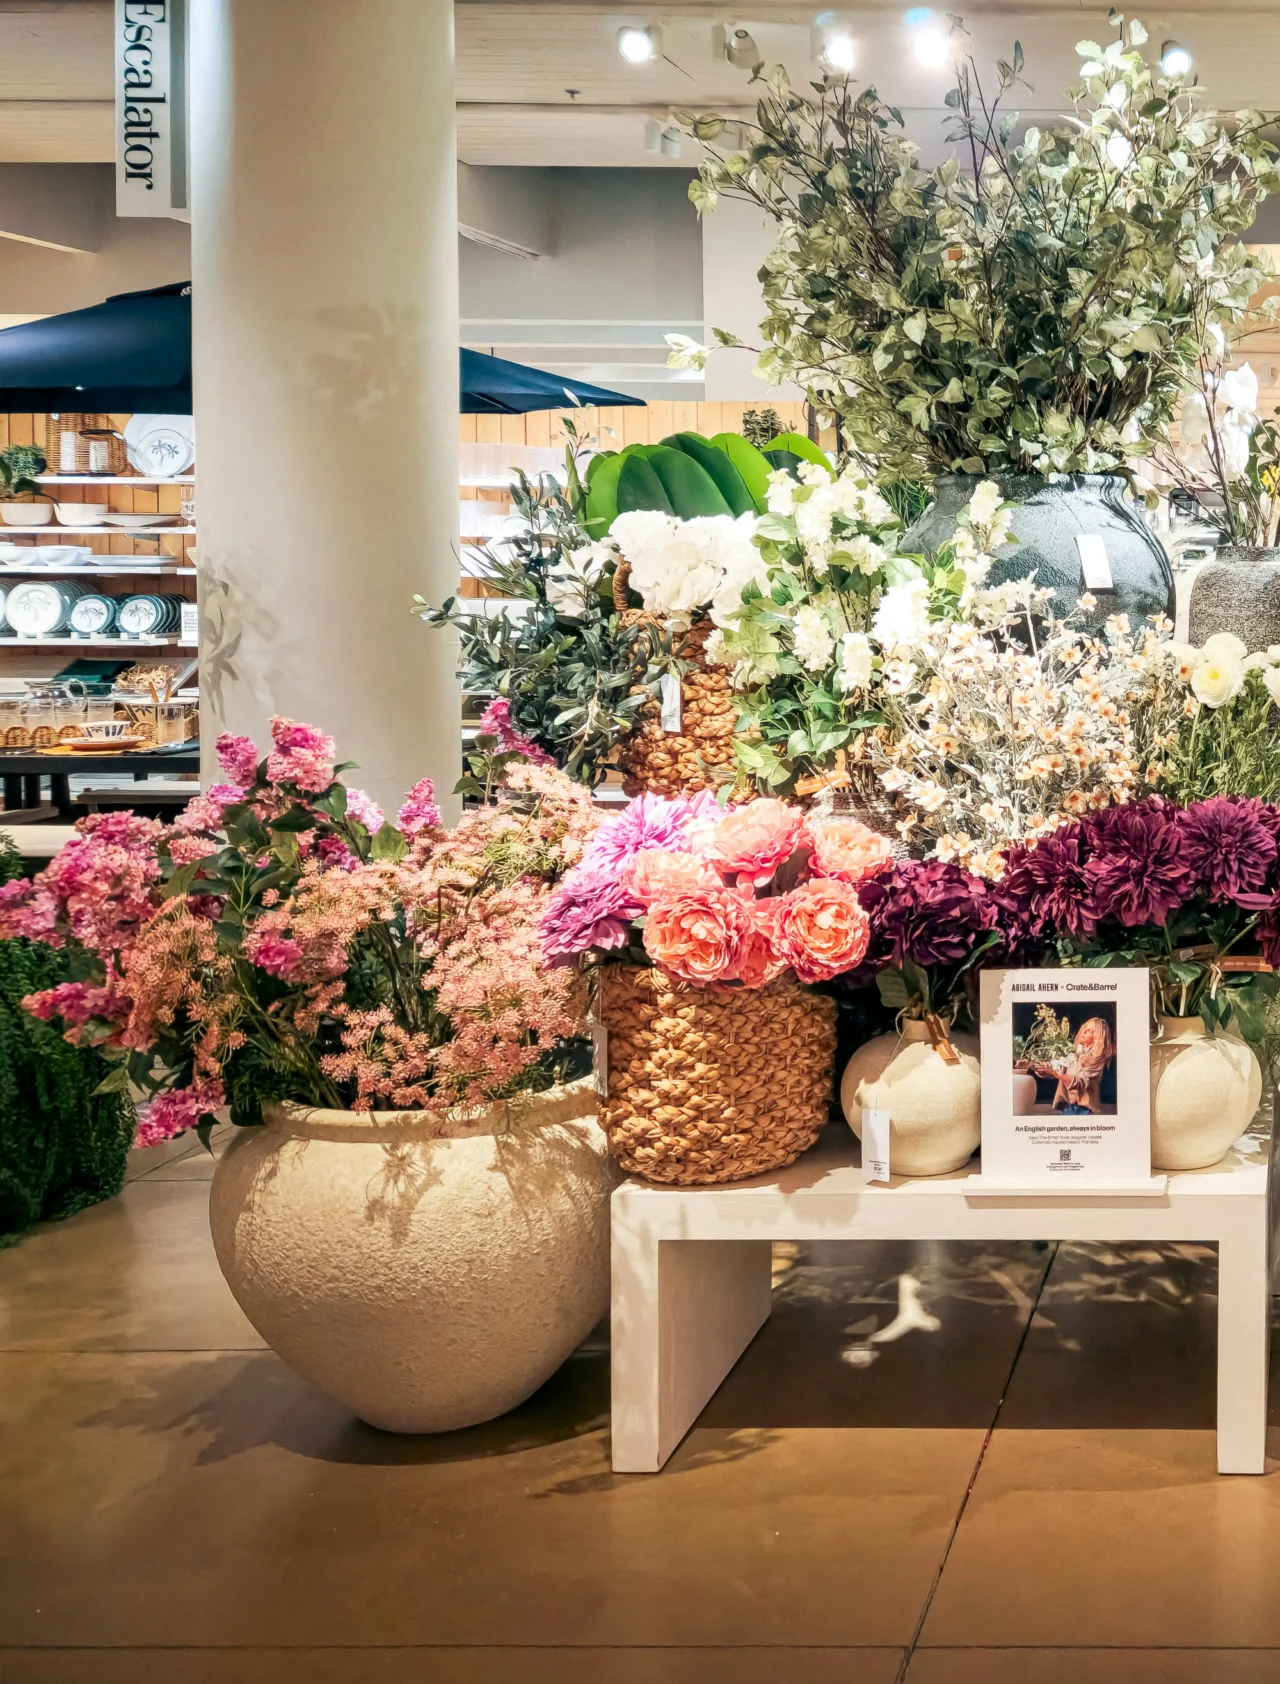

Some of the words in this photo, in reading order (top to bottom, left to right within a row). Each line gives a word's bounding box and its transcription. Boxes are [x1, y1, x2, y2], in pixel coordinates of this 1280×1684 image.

[124, 0, 167, 190] Escalator
[1011, 983, 1036, 992] ABIGAIL
[1038, 983, 1059, 992] AHERN
[1065, 983, 1117, 992] Crate&Barrel
[1024, 1125, 1046, 1133] English
[1046, 1125, 1070, 1133] garden,
